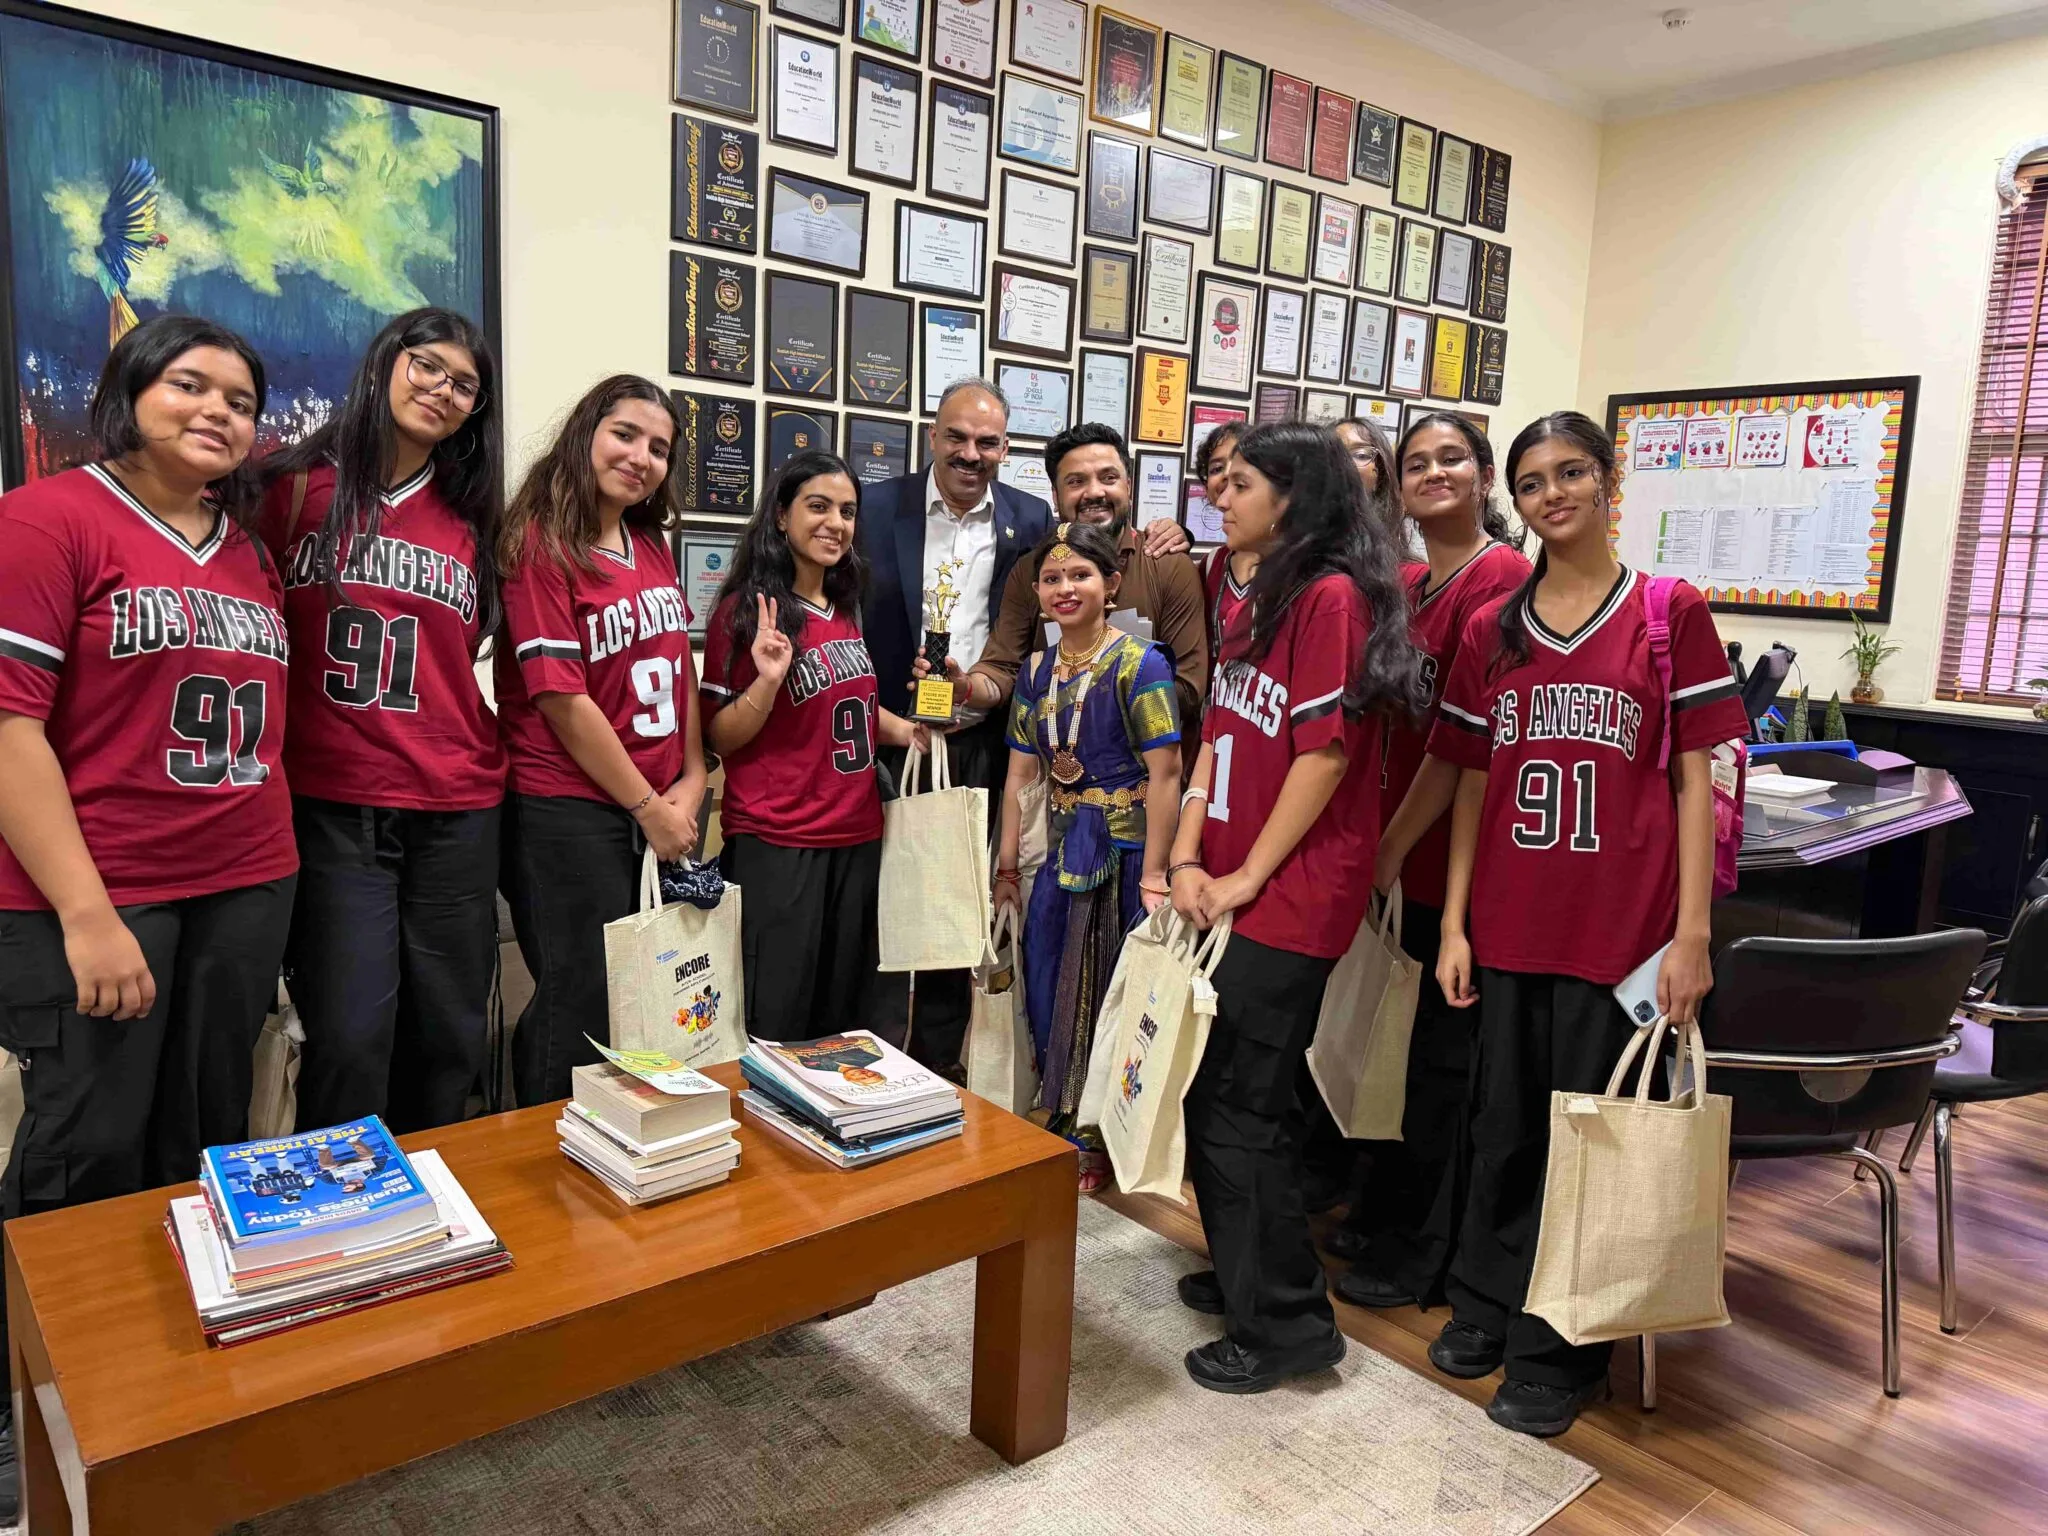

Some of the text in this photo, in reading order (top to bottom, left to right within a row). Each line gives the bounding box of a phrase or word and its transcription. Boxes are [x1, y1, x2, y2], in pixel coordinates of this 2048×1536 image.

[700, 14, 737, 32] EducationWorld
[788, 62, 823, 79] EducationWorld
[871, 91, 901, 106] EducationWorld
[947, 115, 975, 129] EducationWorld
[686, 119, 702, 239] EducationToday
[717, 173, 744, 184] Certificate
[686, 256, 700, 374] EducationToday
[716, 312, 741, 322] Certificate
[788, 338, 814, 347] Certificate
[867, 352, 891, 361] Certificate
[1025, 386, 1043, 395] SCHOOLS
[715, 444, 742, 454] Certificate
[866, 461, 890, 470] Certificate
[341, 534, 477, 624] ANGELES
[110, 587, 189, 659] LOS
[587, 598, 635, 663] LOS
[324, 605, 419, 712] 91
[167, 674, 269, 787] 91
[1526, 683, 1643, 761] ANGELES
[1512, 759, 1600, 852] 91
[675, 952, 711, 983] ENCORE
[227, 1126, 369, 1159] THE AI THREAT
[318, 1182, 414, 1213] Business
[248, 1206, 317, 1225] Today
